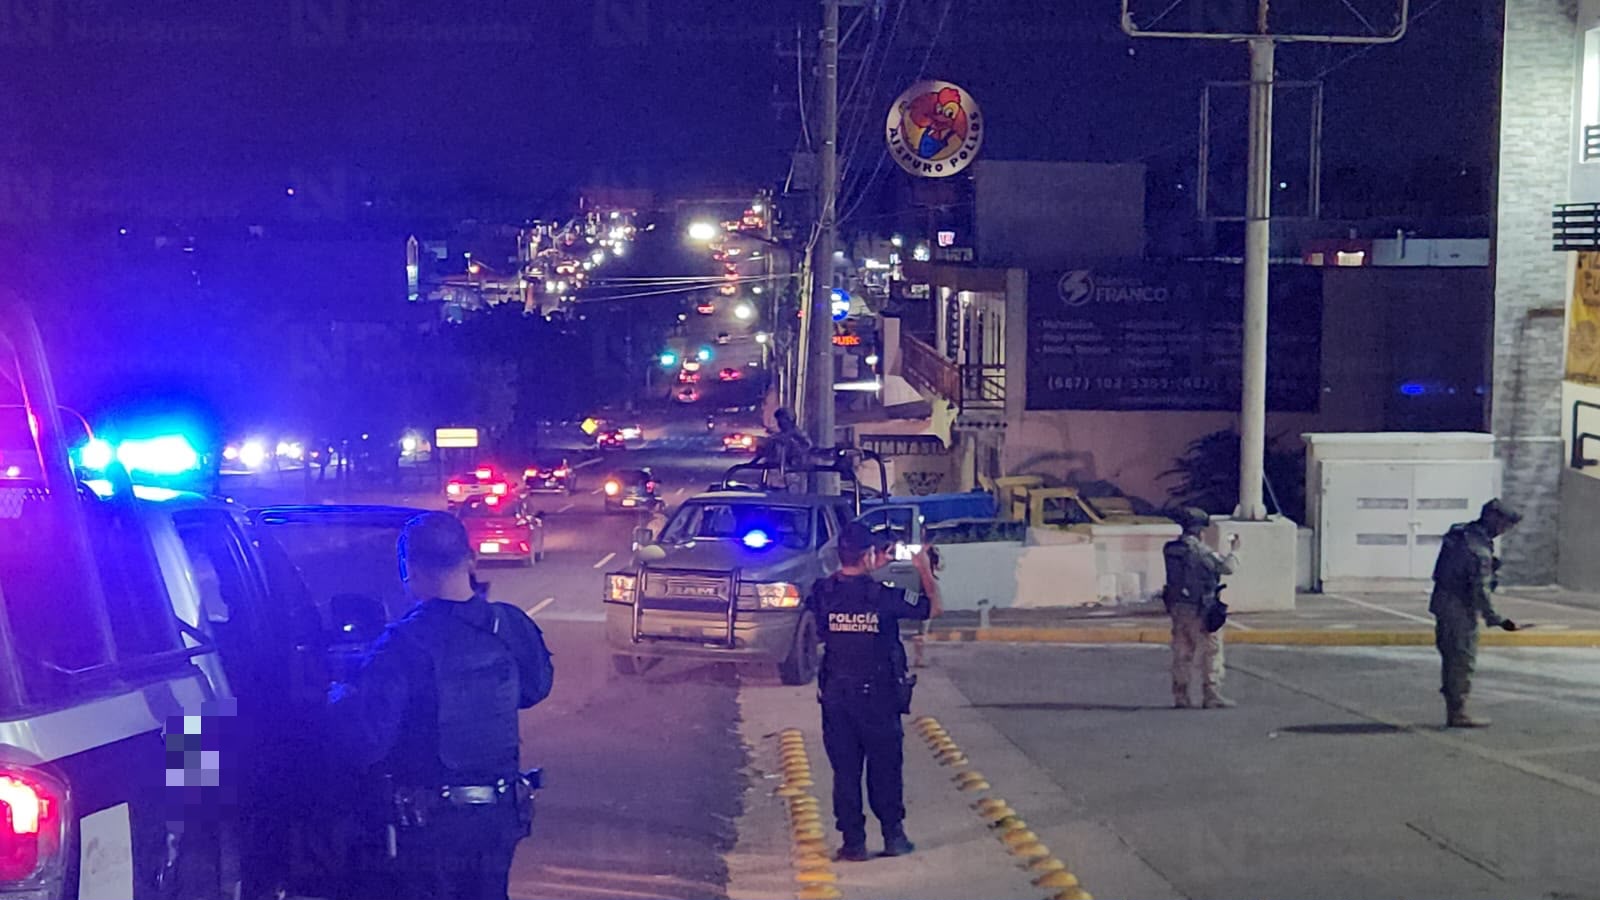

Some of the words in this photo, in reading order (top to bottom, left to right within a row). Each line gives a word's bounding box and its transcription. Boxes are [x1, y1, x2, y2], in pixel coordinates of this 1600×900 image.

[888, 127, 943, 173] AISPURO
[950, 111, 981, 168] POLLOS
[1095, 287, 1168, 303] FRANCO
[828, 611, 879, 624] POLICÍA
[829, 623, 880, 634] MUNICIPAL
